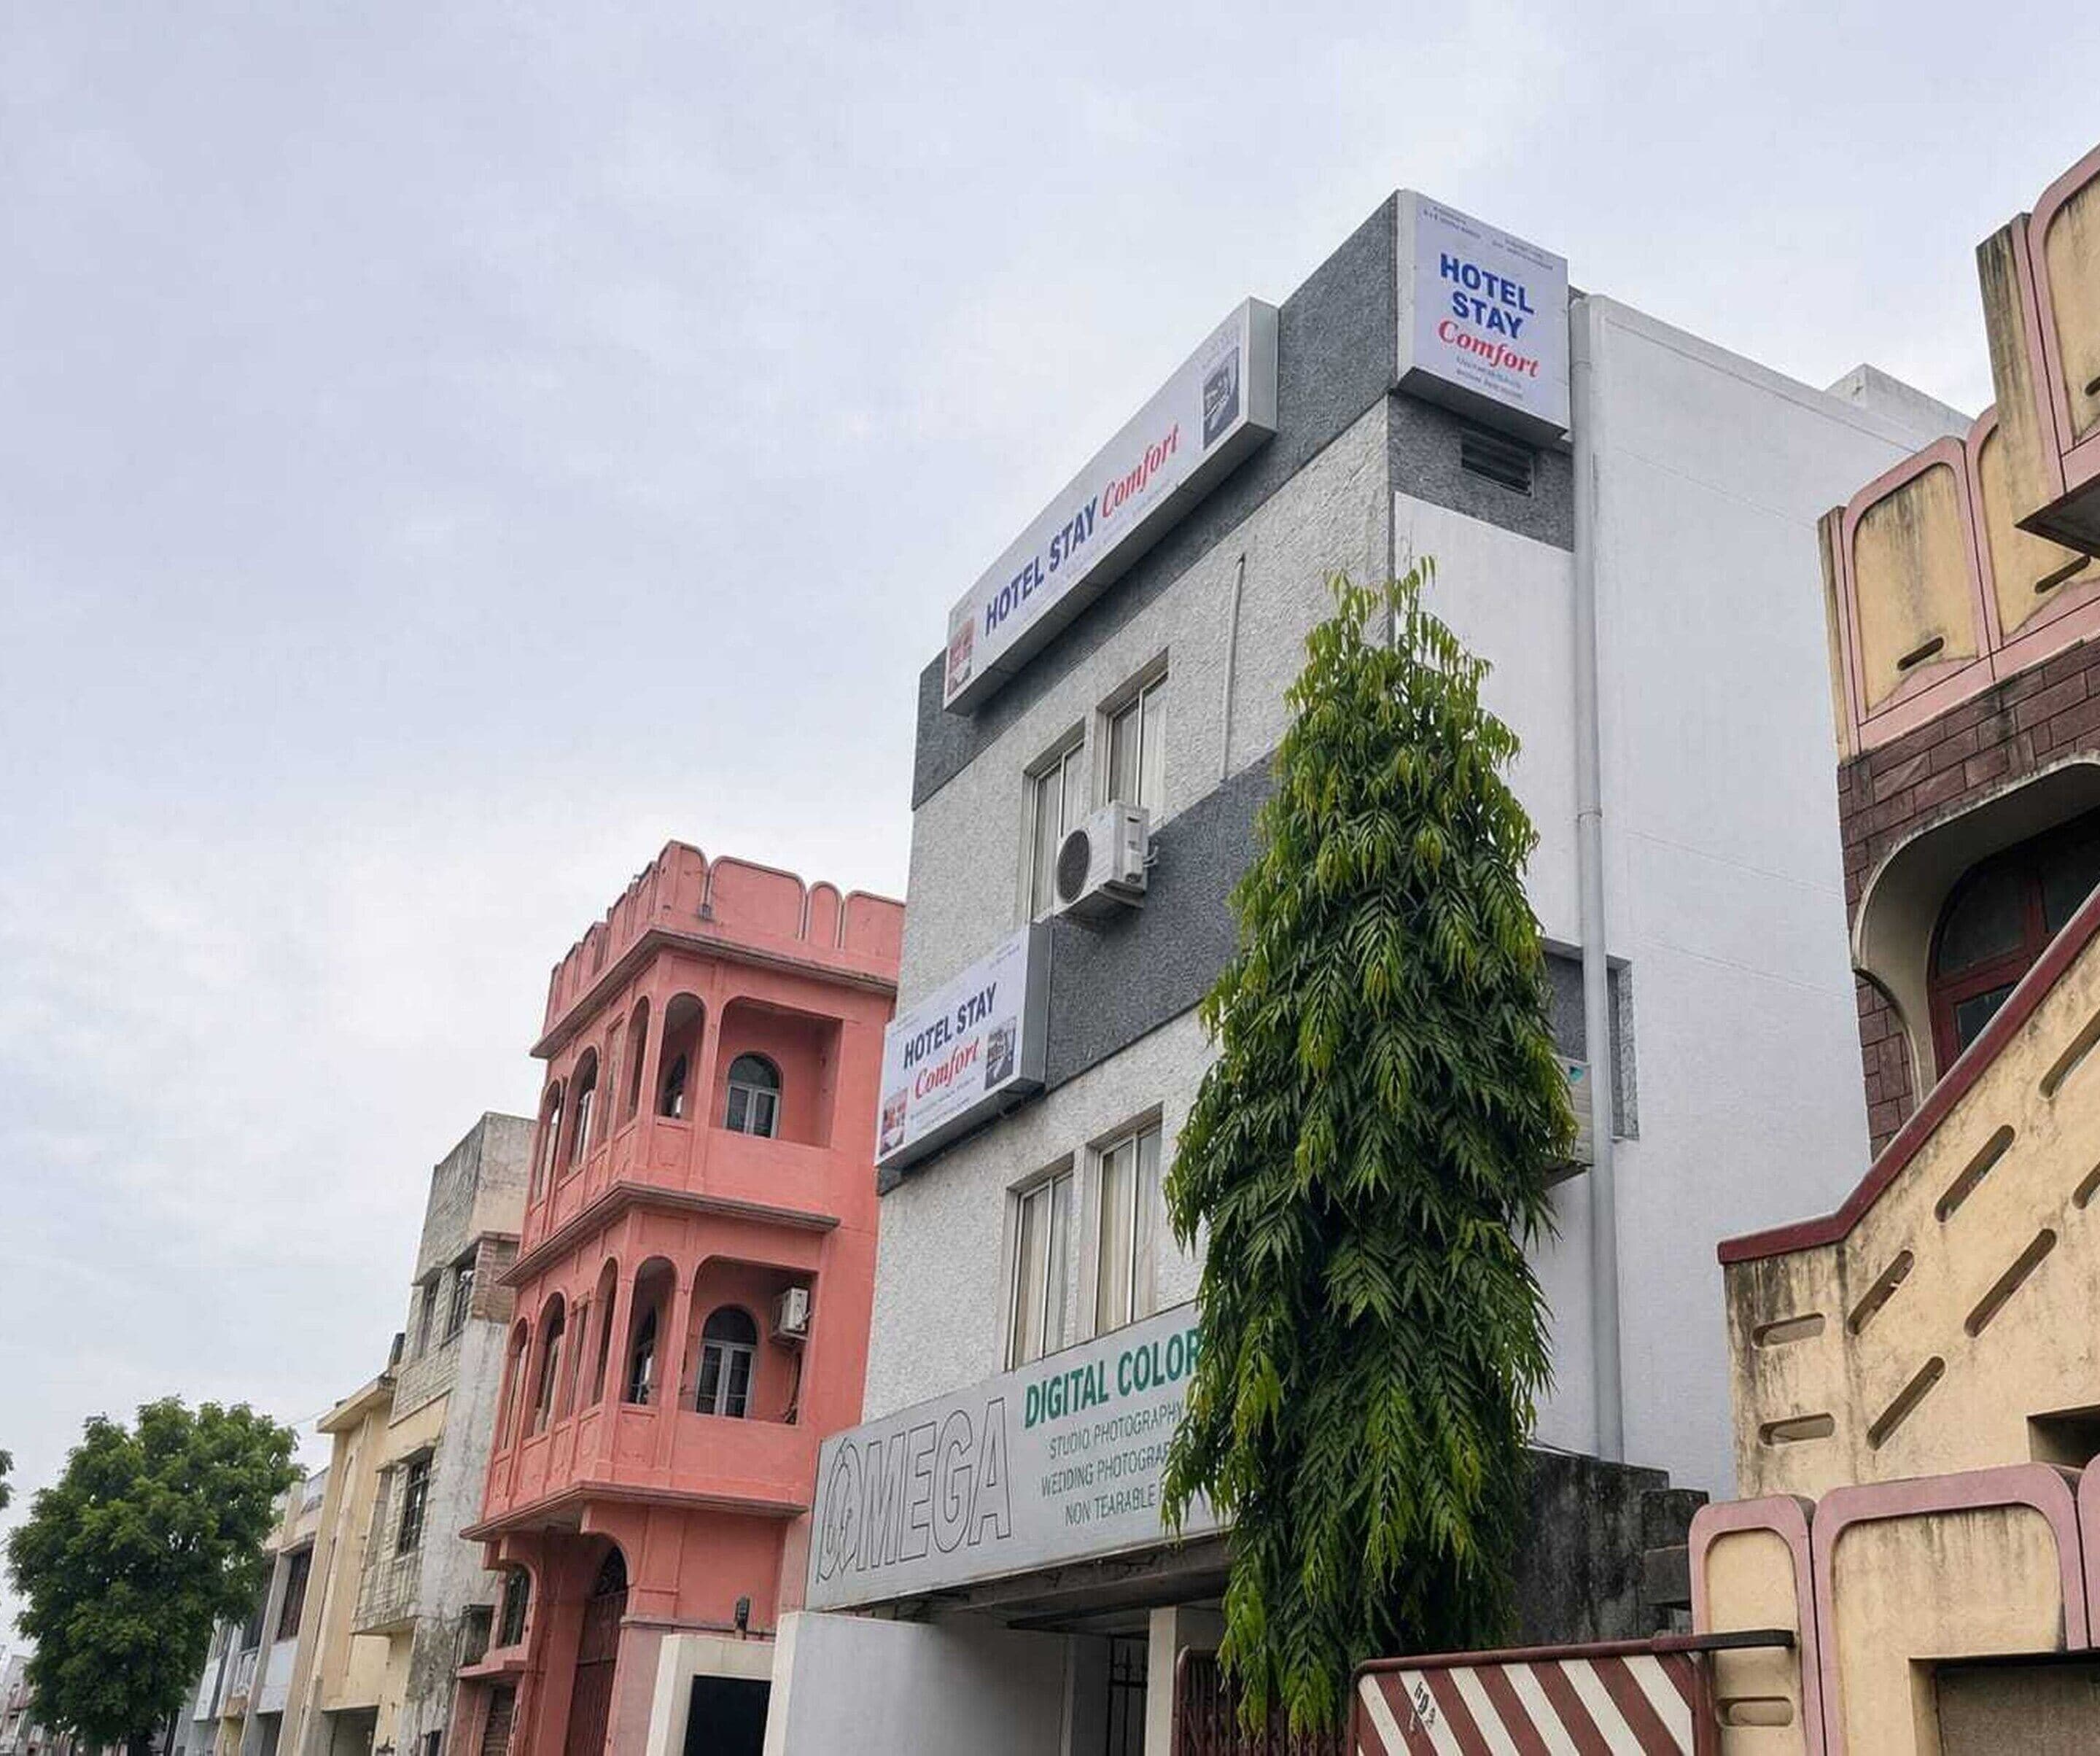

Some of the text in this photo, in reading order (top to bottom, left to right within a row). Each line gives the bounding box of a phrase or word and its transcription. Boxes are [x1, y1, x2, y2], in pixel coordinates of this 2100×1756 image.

[1440, 252, 1535, 315] HOTEL
[1452, 291, 1524, 340] STAY
[1438, 319, 1540, 378] Comfort
[984, 556, 1045, 637] HOTEL
[1049, 494, 1099, 573] STAY
[1102, 424, 1179, 519] Comfort
[903, 1015, 952, 1070] HOTEL
[956, 982, 997, 1035] STAY
[914, 1036, 980, 1100] Comfort
[1024, 1360, 1110, 1429] DIGITAL
[1049, 1399, 1185, 1460] STUDIO PHOTOGRAPHY
[816, 1397, 1012, 1584] OMEGA
[1041, 1464, 1094, 1497] WEDDING
[1065, 1500, 1091, 1527] NON
[1094, 1483, 1156, 1520] TEARABLE
